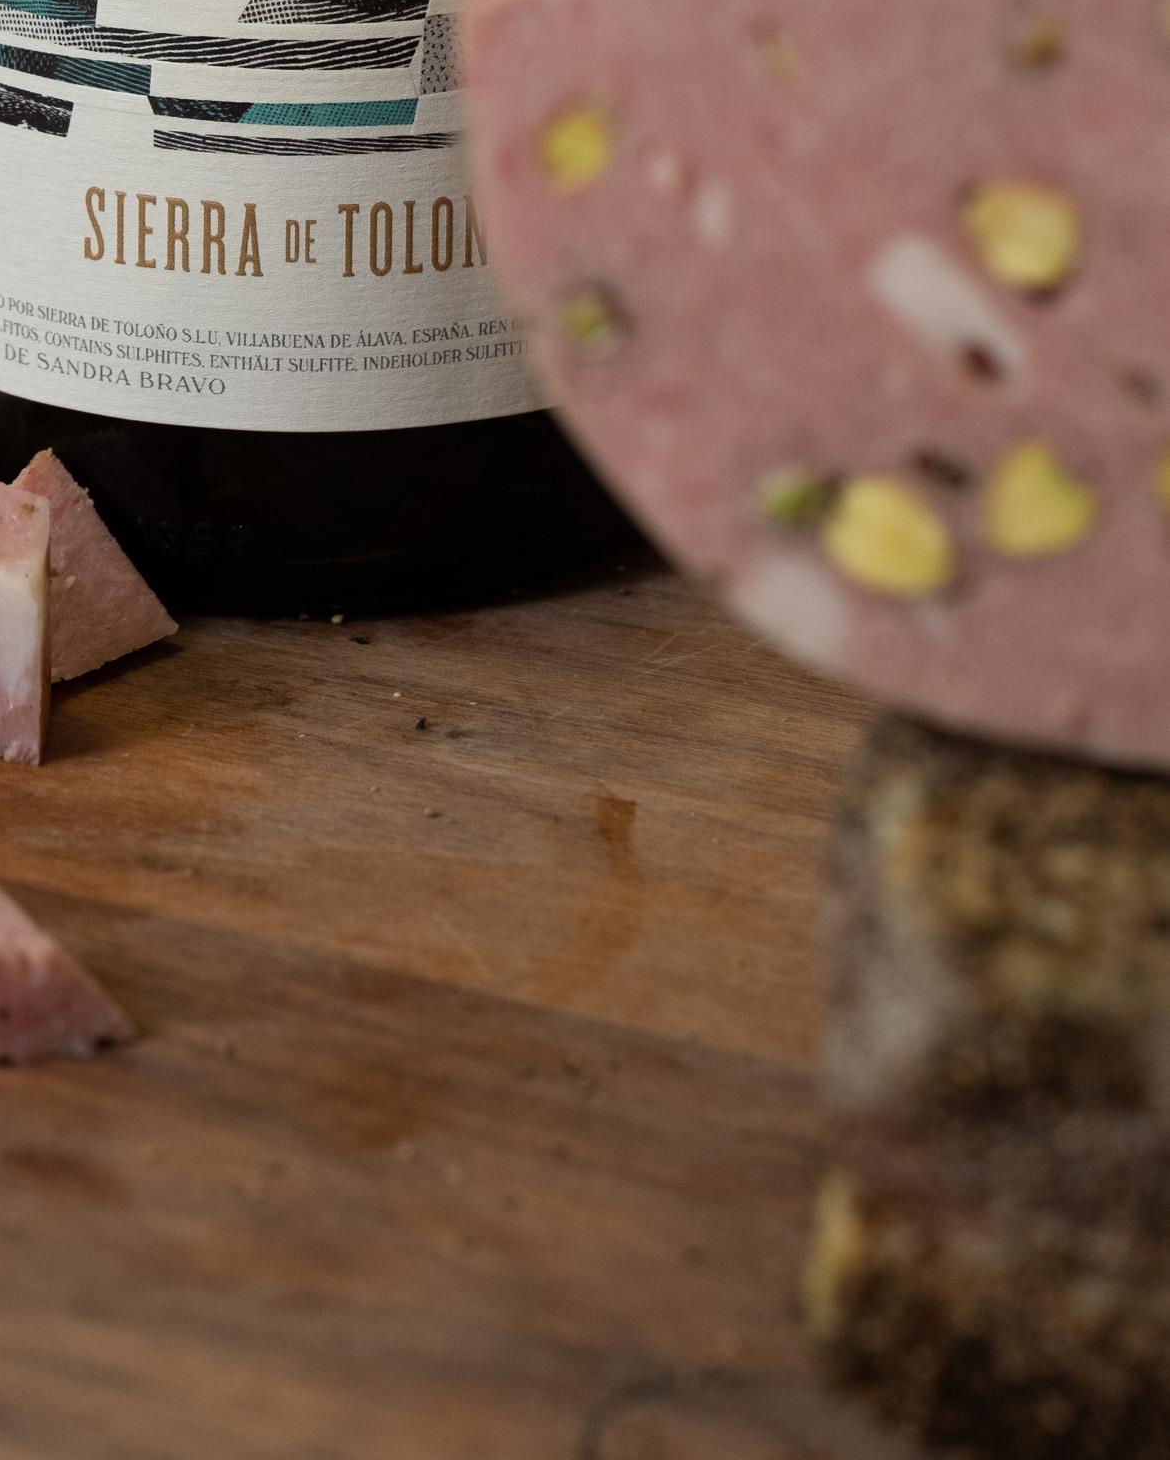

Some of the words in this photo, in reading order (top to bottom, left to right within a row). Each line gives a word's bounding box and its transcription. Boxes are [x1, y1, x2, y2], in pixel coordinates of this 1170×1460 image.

[84, 186, 264, 277] SIERRA
[285, 219, 317, 263] DE
[8, 297, 34, 317] POR
[37, 305, 86, 329] SIERRA
[91, 316, 110, 333] DE
[114, 320, 177, 341] TOLOÑO
[226, 331, 326, 348] VILLABUENA
[330, 334, 351, 348] DE
[5, 343, 30, 365] DE
[37, 352, 131, 386] SANDRA
[140, 371, 225, 395] BRAVO
[45, 331, 113, 357] CONTAINS
[210, 354, 283, 371] ENTHÄLT
[364, 349, 462, 370] INDEHOLDER
